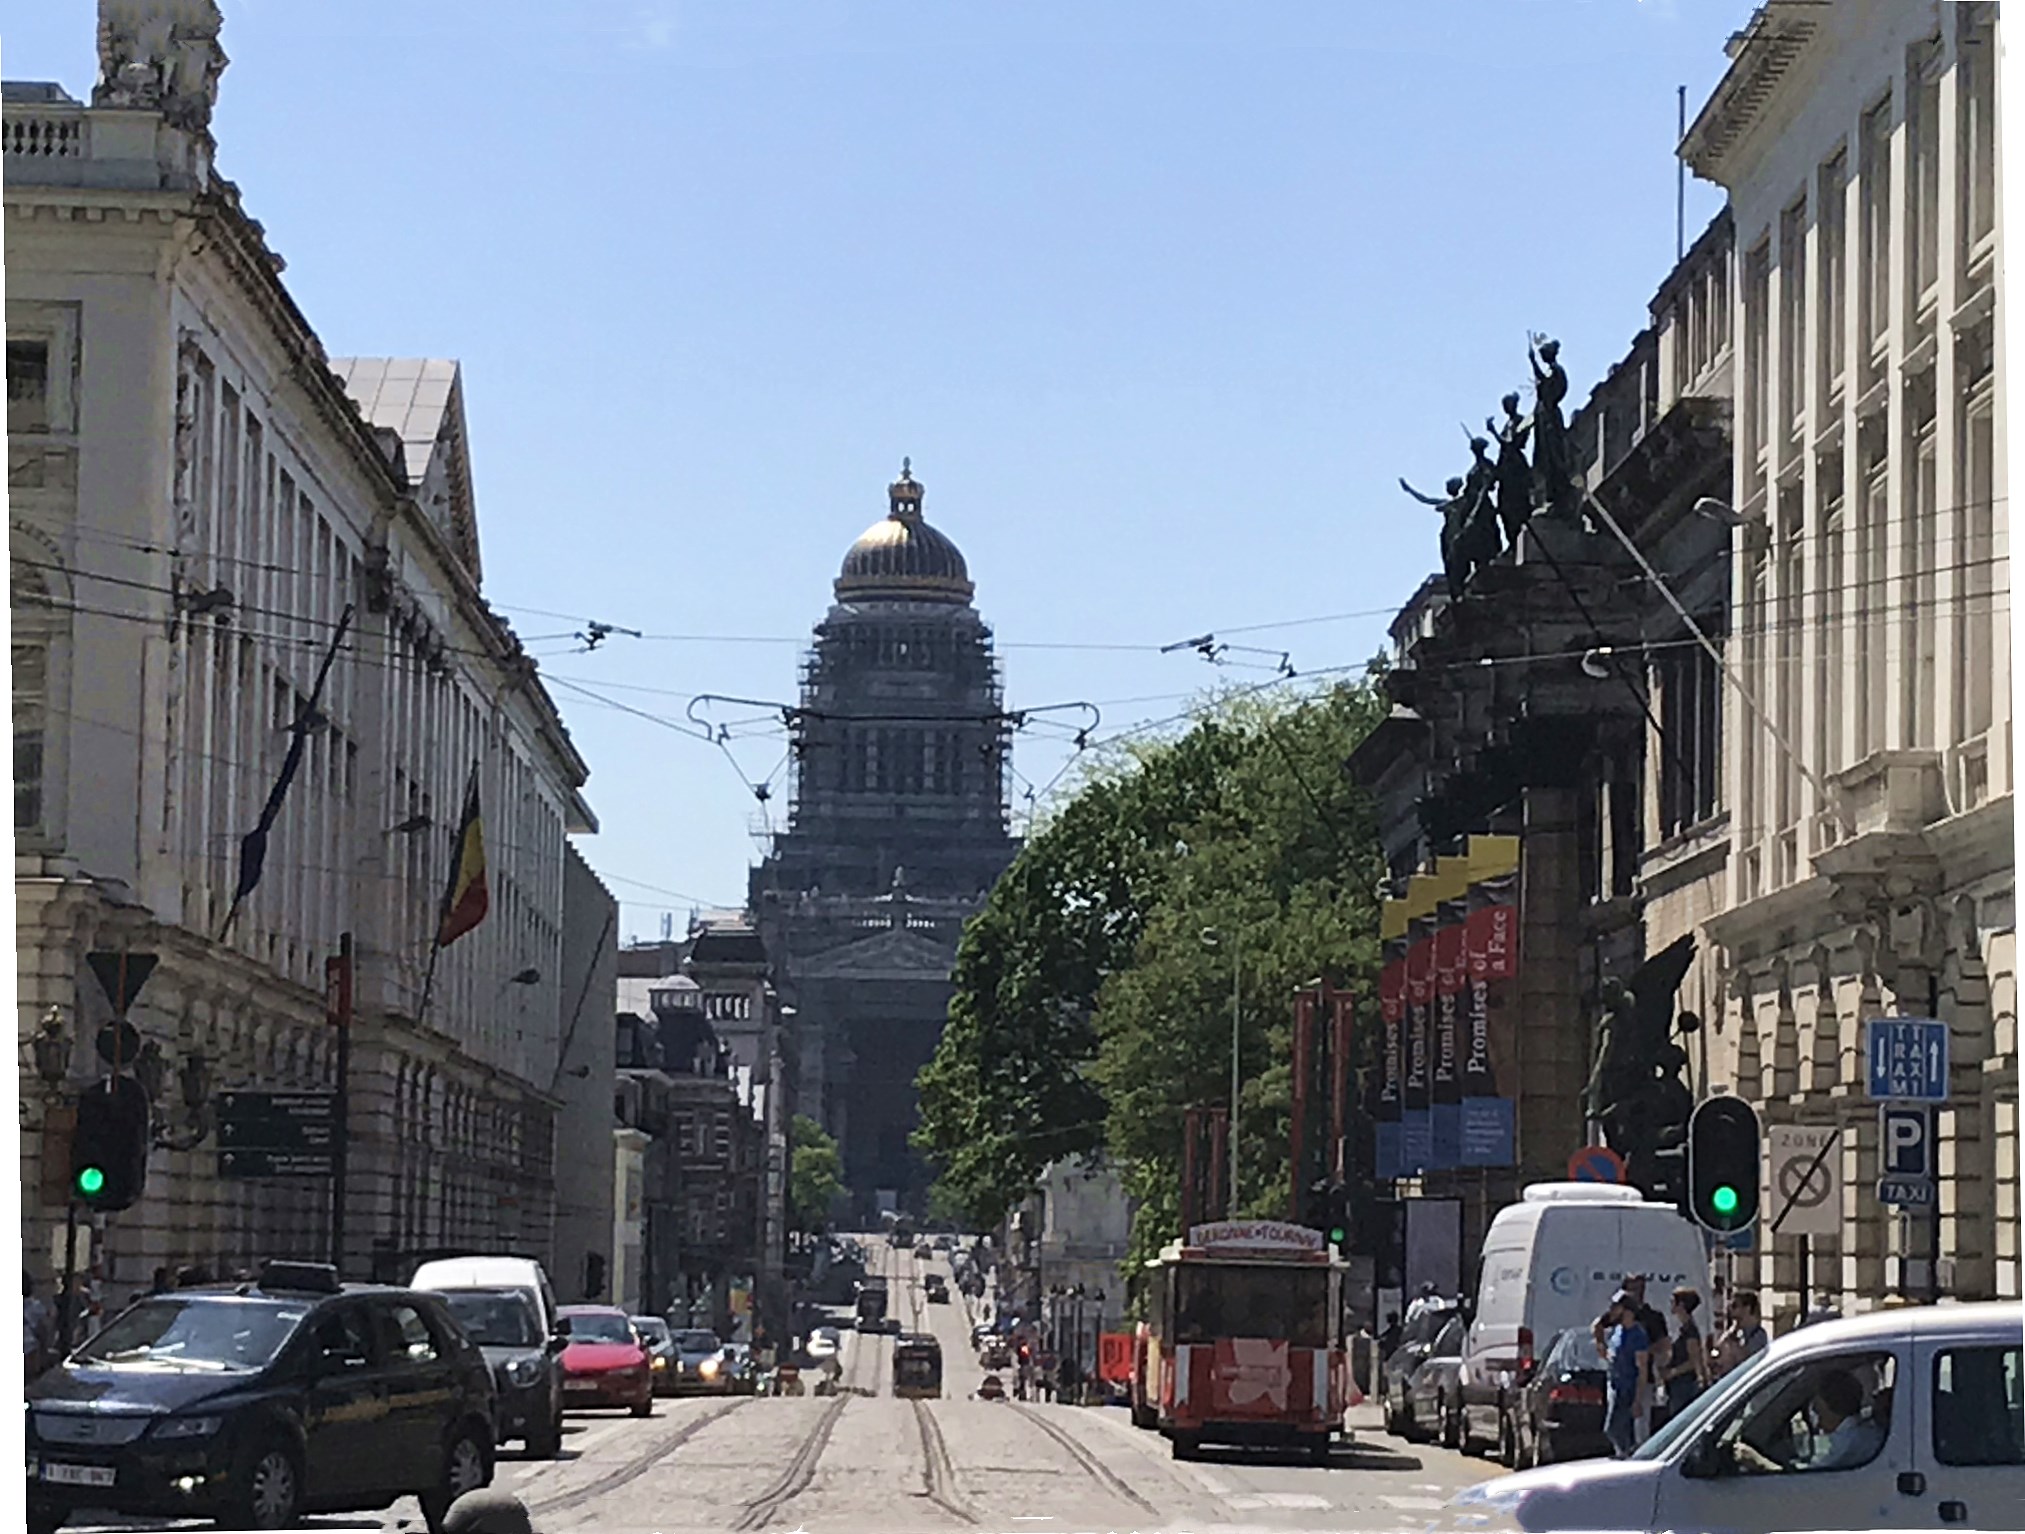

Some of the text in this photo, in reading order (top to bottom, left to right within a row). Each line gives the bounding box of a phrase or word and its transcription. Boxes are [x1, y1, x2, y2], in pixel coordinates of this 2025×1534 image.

[1489, 911, 1508, 971] a Face
[1408, 1005, 1425, 1088] Promises
[1436, 968, 1456, 1081] Promises of
[1468, 951, 1488, 1073] Promises of
[1382, 1023, 1398, 1101] Promises
[1893, 1025, 1908, 1095] TRAM
[1910, 1025, 1922, 1096] TAXI
[1888, 1118, 1922, 1167] P
[1887, 1184, 1927, 1202] TAXI
